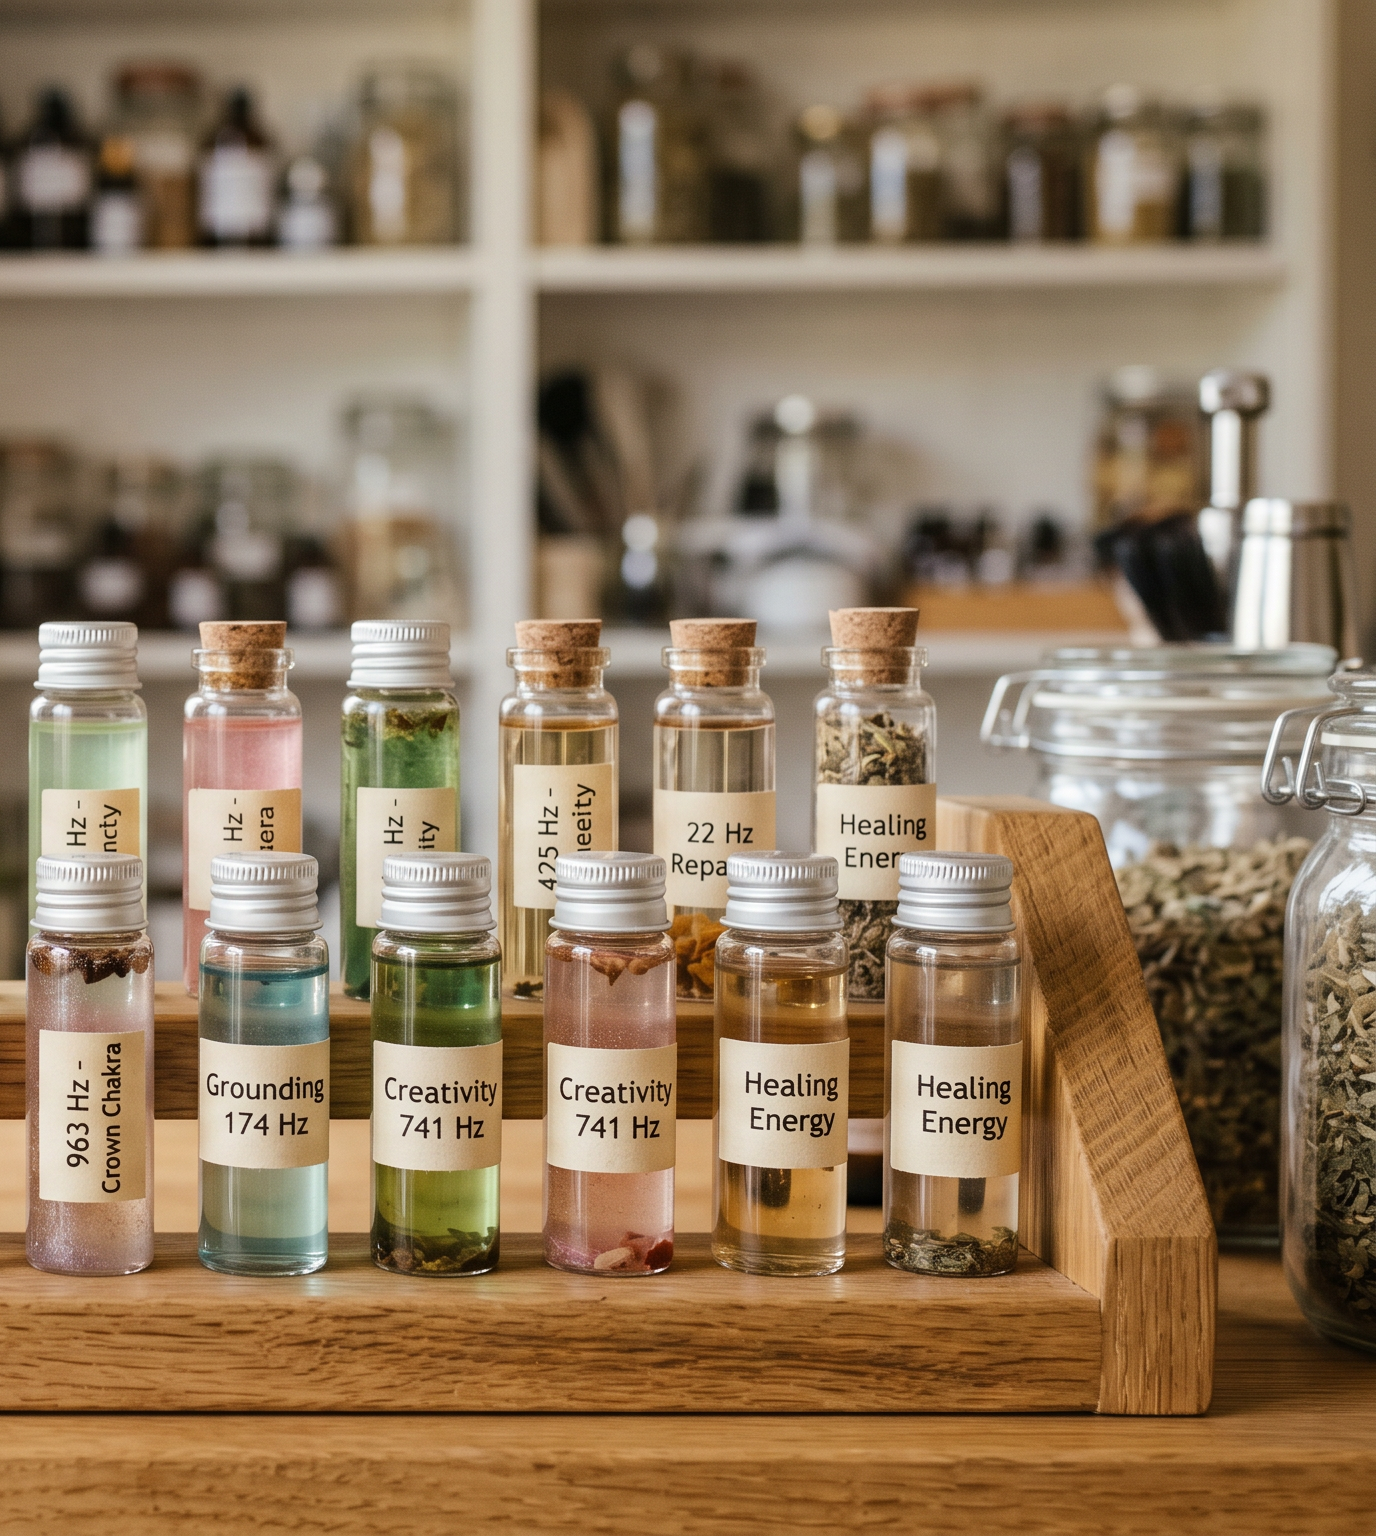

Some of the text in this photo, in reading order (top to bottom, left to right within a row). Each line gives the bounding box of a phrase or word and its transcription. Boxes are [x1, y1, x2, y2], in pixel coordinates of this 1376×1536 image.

[67, 817, 86, 846] Hz
[223, 813, 242, 841] Hz
[384, 816, 403, 844] Hz
[538, 806, 558, 835] Hz
[688, 822, 753, 843] 22 Hz
[841, 814, 926, 840] Healing
[537, 846, 560, 892] 425
[671, 852, 728, 882] Repa
[844, 846, 902, 870] Ener
[67, 1080, 89, 1111] Hz
[207, 1073, 324, 1103] Grounding
[385, 1077, 497, 1106] Creativity
[560, 1077, 672, 1107] Creativity
[746, 1071, 838, 1102] Healing
[918, 1074, 1011, 1105] Healing
[101, 1042, 121, 1193] Crown Chakra
[225, 1112, 308, 1136] 174 Hz
[400, 1114, 484, 1139] 741 Hz
[576, 1114, 660, 1139] 741 Hz
[751, 1107, 835, 1138] Energy
[923, 1110, 1008, 1141] Energy
[67, 1123, 89, 1167] 963
